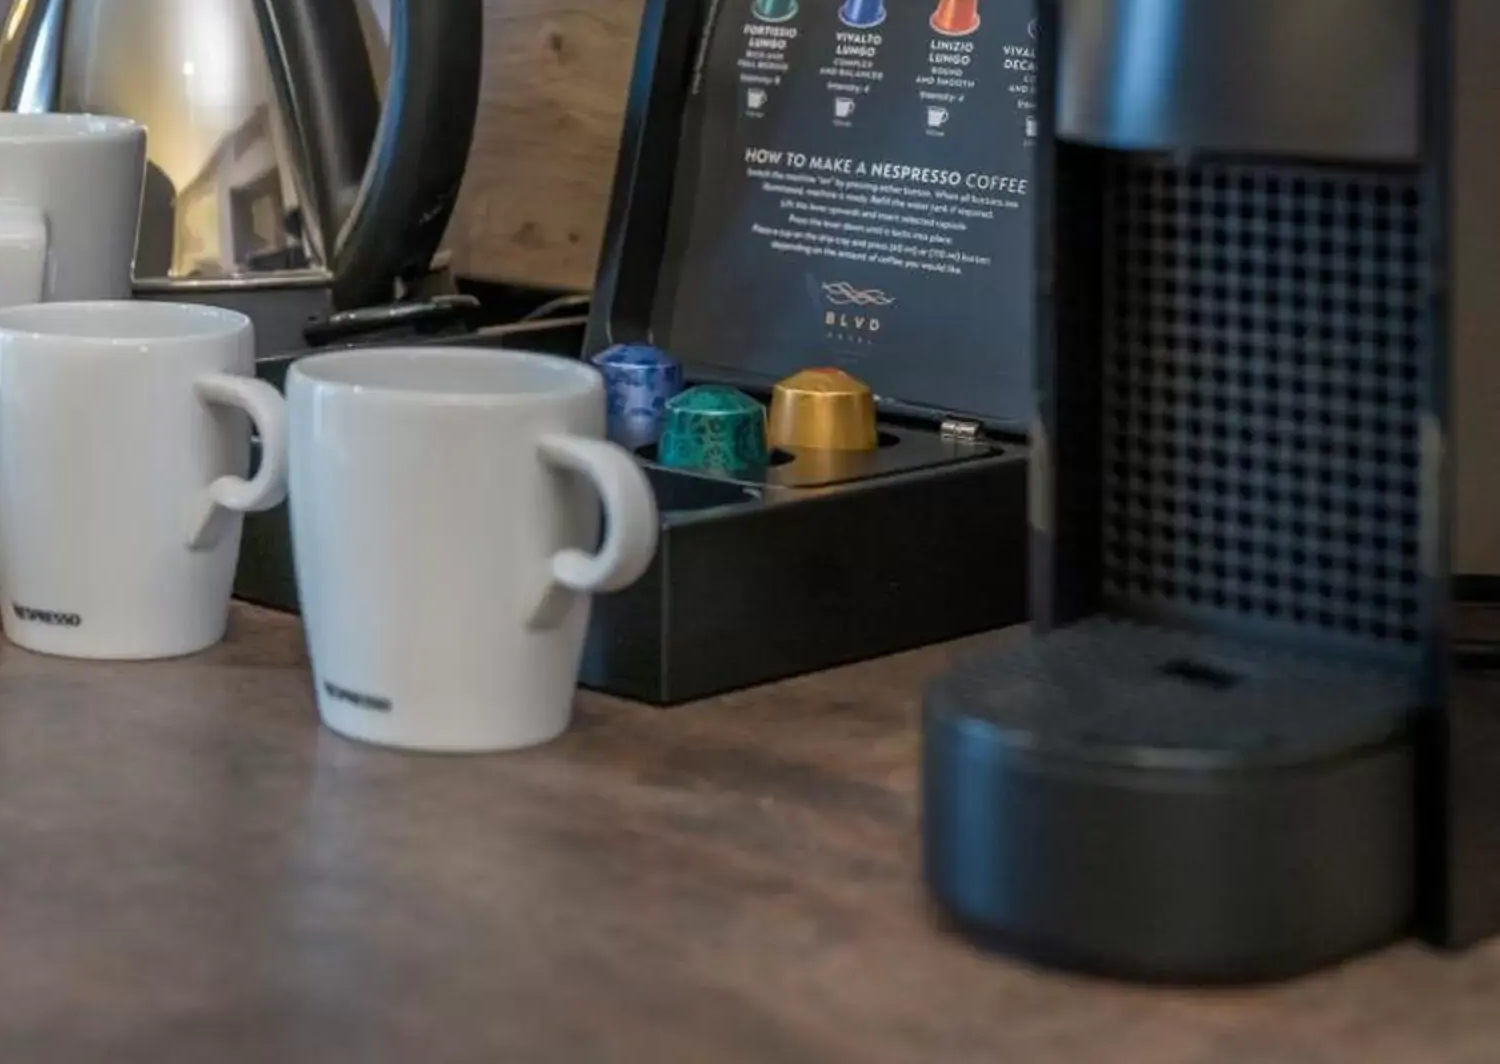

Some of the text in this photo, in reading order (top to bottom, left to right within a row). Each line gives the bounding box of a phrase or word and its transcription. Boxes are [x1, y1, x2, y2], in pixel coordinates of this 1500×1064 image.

[835, 32, 882, 46] VIVALTO
[930, 40, 975, 53] LINIZIO
[929, 52, 971, 65] LUNGO
[745, 147, 1028, 196] HOW TO MAKE A NESPRESSO COFFEE
[825, 311, 880, 331] BLVD
[11, 602, 82, 628] NESPRESSO
